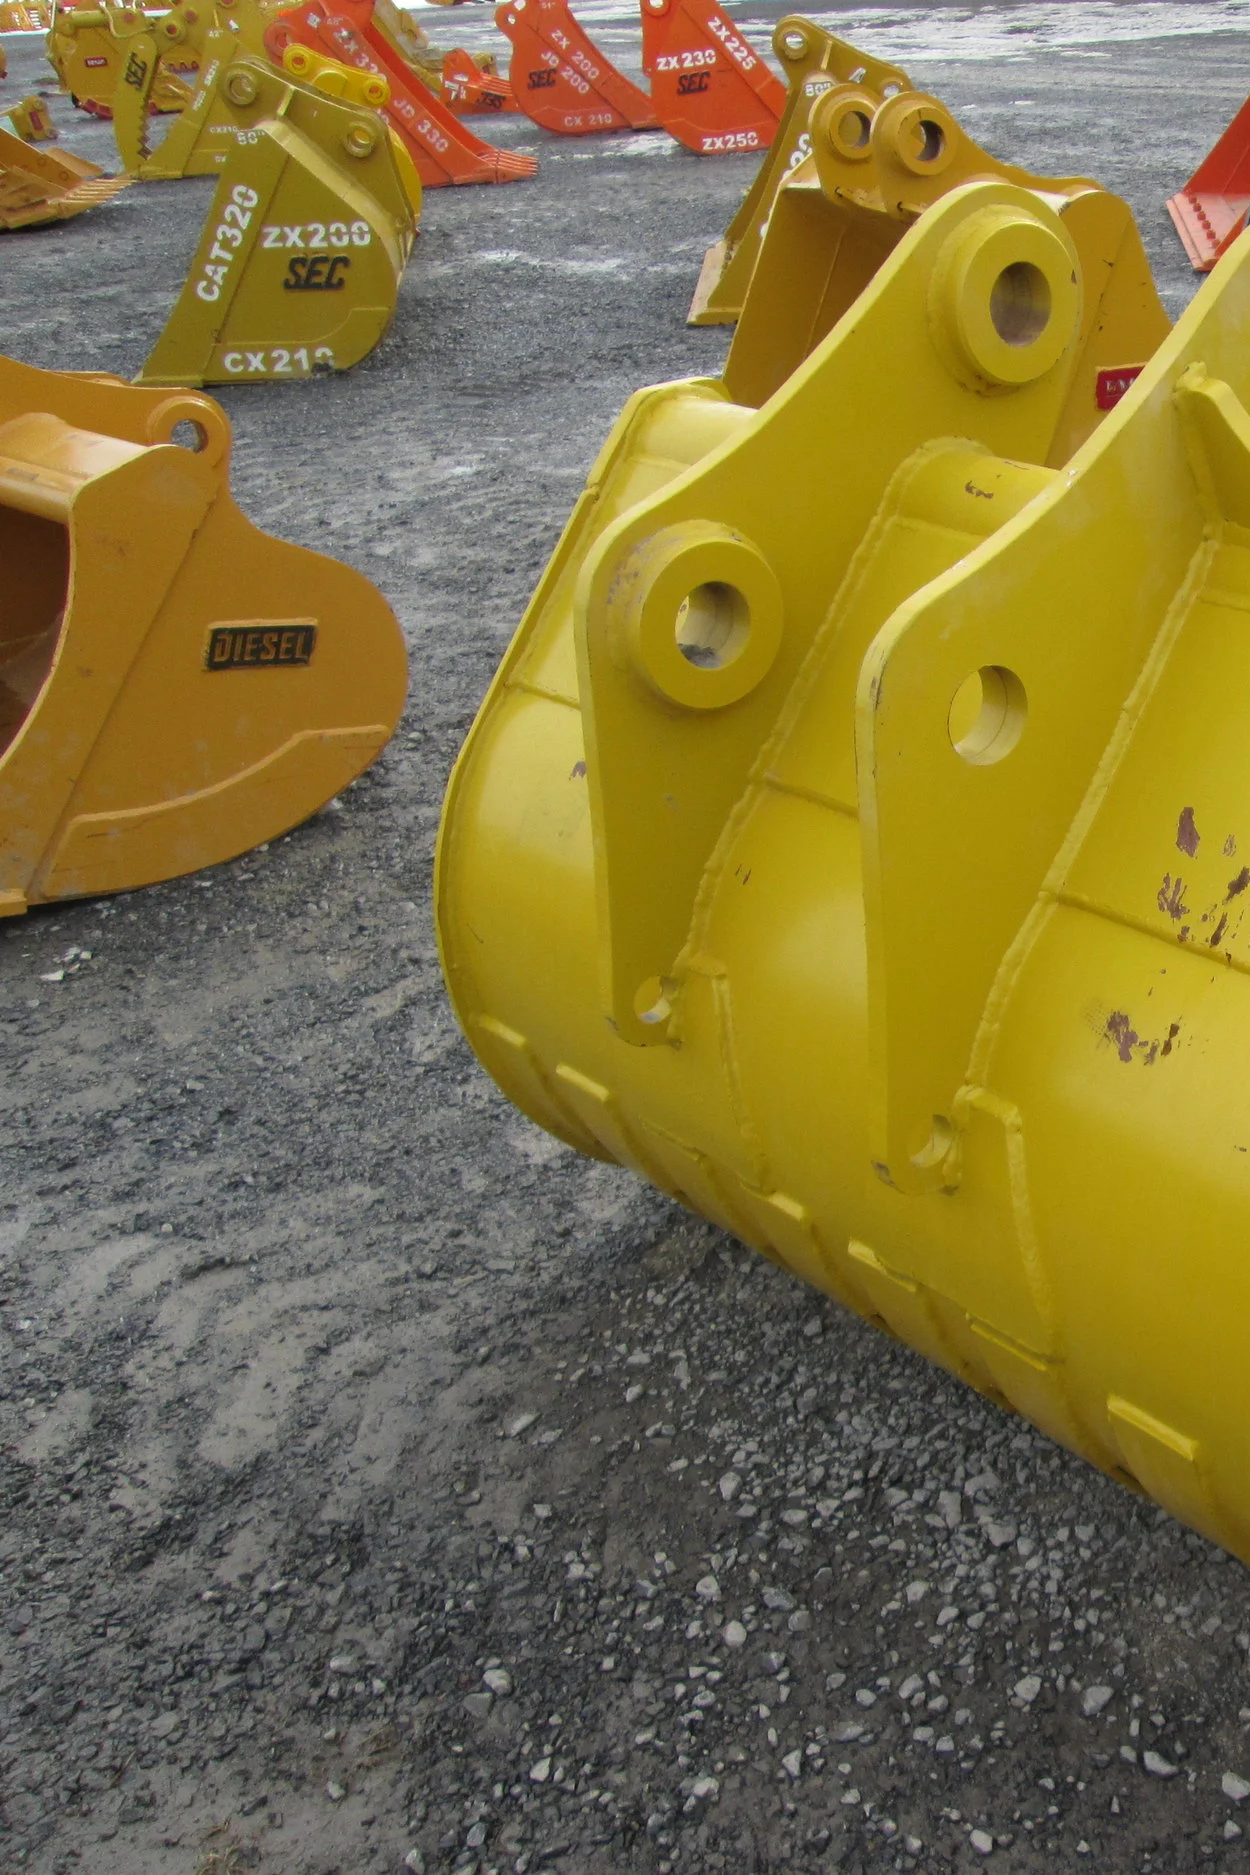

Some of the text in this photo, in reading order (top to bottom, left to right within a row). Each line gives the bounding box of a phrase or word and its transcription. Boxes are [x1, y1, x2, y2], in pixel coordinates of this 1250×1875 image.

[676, 71, 711, 96] SEC
[702, 131, 759, 152] ZX250
[196, 184, 260, 302] CAT320
[261, 220, 372, 249] ZX200
[283, 255, 352, 291] SEC
[213, 630, 311, 663] DIESEL
